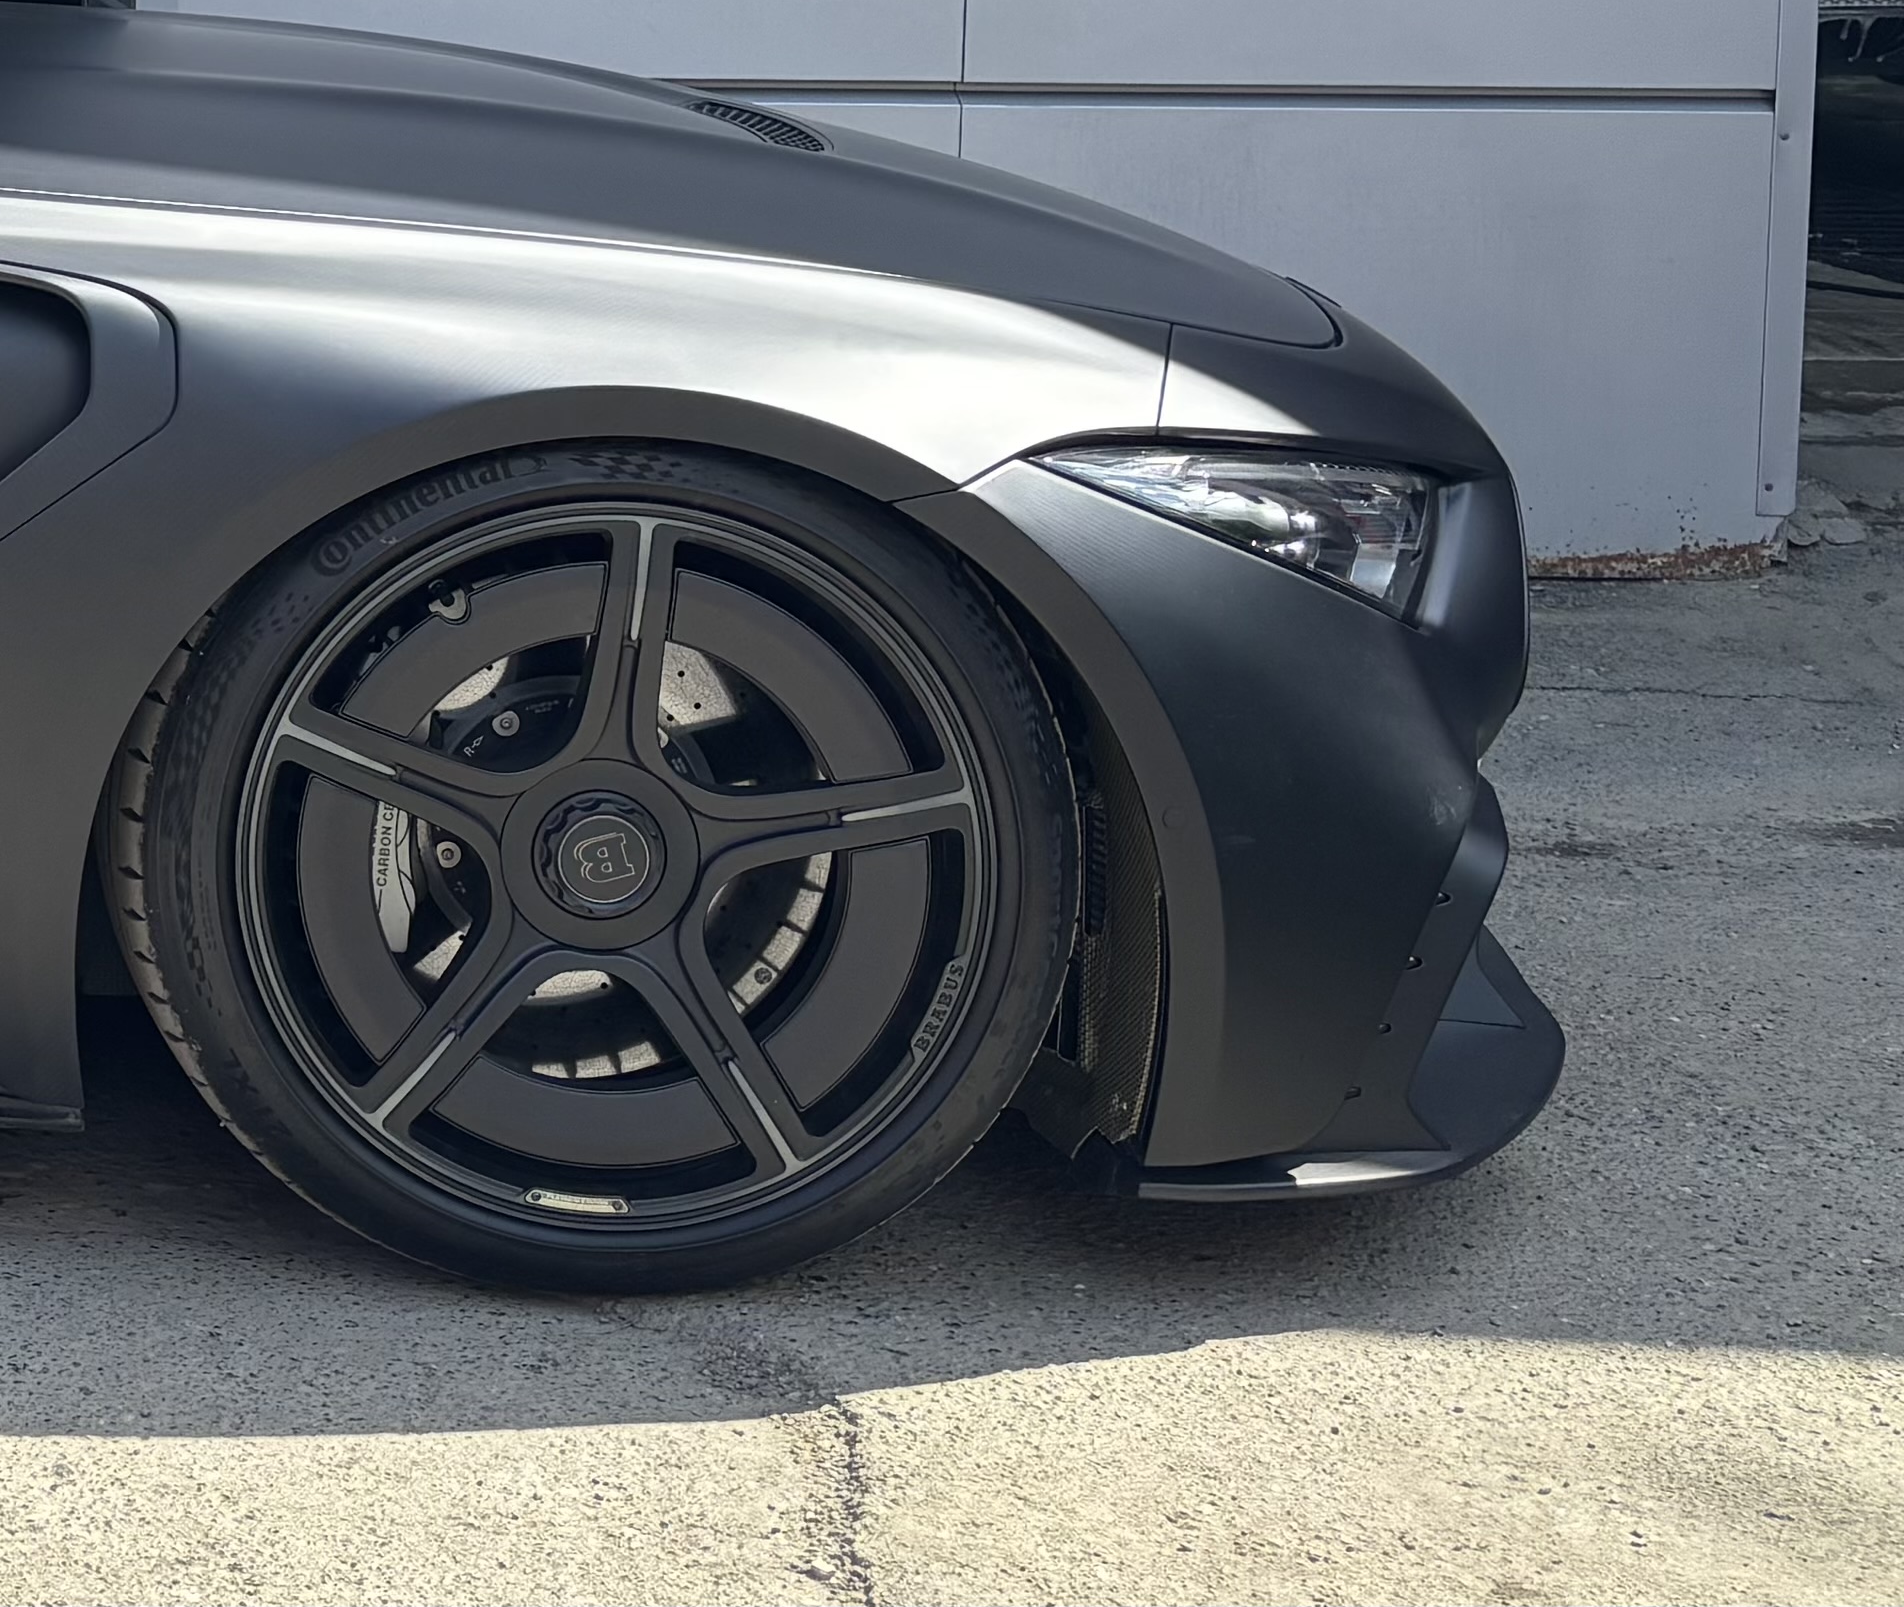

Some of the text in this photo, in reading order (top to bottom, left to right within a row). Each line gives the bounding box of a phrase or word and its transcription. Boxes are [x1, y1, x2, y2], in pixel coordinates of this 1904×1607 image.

[310, 455, 518, 577] Continental
[375, 825, 393, 888] CARBON
[572, 830, 637, 885] B
[913, 963, 964, 1053] BRABUS
